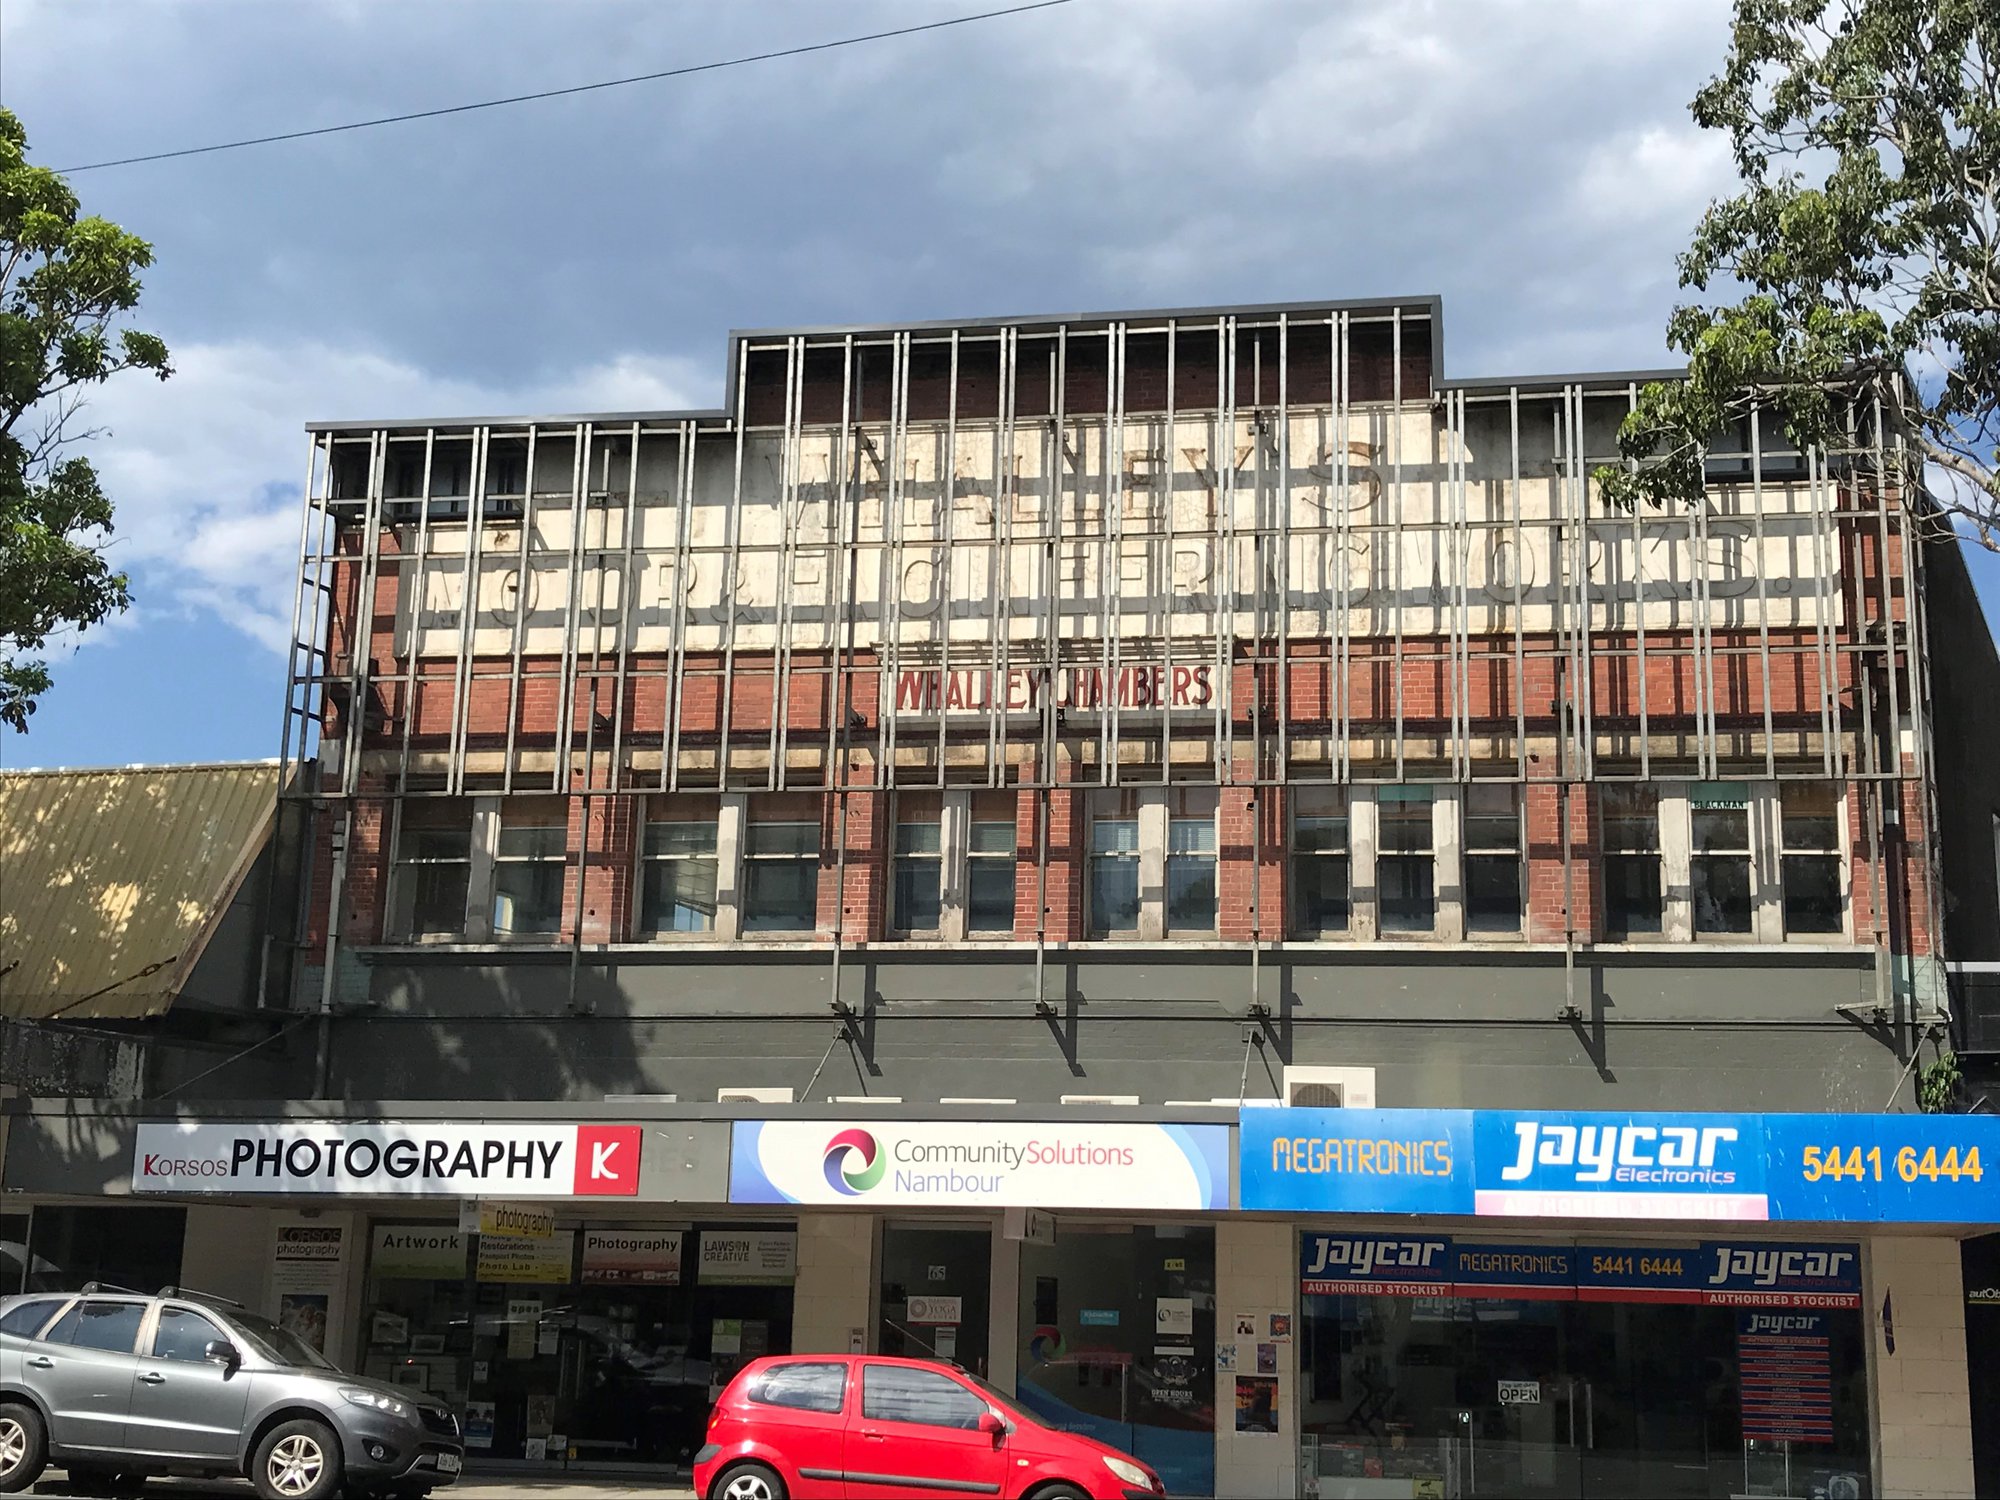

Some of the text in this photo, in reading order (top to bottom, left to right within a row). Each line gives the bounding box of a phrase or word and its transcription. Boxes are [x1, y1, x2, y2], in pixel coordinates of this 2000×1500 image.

[896, 665, 1213, 711] WHALLEY CHAMBERS
[230, 1138, 563, 1179] PHOTOGRAPHY
[1273, 1137, 1452, 1176] MEGATRONICS
[1501, 1122, 1738, 1182] Jaycar
[590, 1141, 621, 1180] K
[1803, 1146, 1983, 1182] 5441 6444
[896, 1168, 1004, 1192] Nambour
[1615, 1167, 1736, 1184] Electronics
[496, 1205, 554, 1237] photography
[383, 1233, 459, 1249] Artwork
[480, 1242, 534, 1251] Restorations
[588, 1237, 678, 1251] Photography
[704, 1240, 750, 1251] LAWSON
[277, 1244, 340, 1256] photography
[704, 1251, 750, 1261] CREATIVE
[513, 1263, 531, 1271] Lab
[1459, 1253, 1568, 1274] MEGATRONICS
[1592, 1256, 1683, 1276] 5441 6444
[930, 1267, 945, 1279] 65
[1307, 1282, 1446, 1296] AUTHORISED STOCKIST
[1709, 1293, 1855, 1307] AUTHORISED STOCKIST
[929, 1304, 957, 1313] YOGA
[1152, 1389, 1193, 1398] OPEN HOURS
[1500, 1389, 1538, 1401] OPEN
